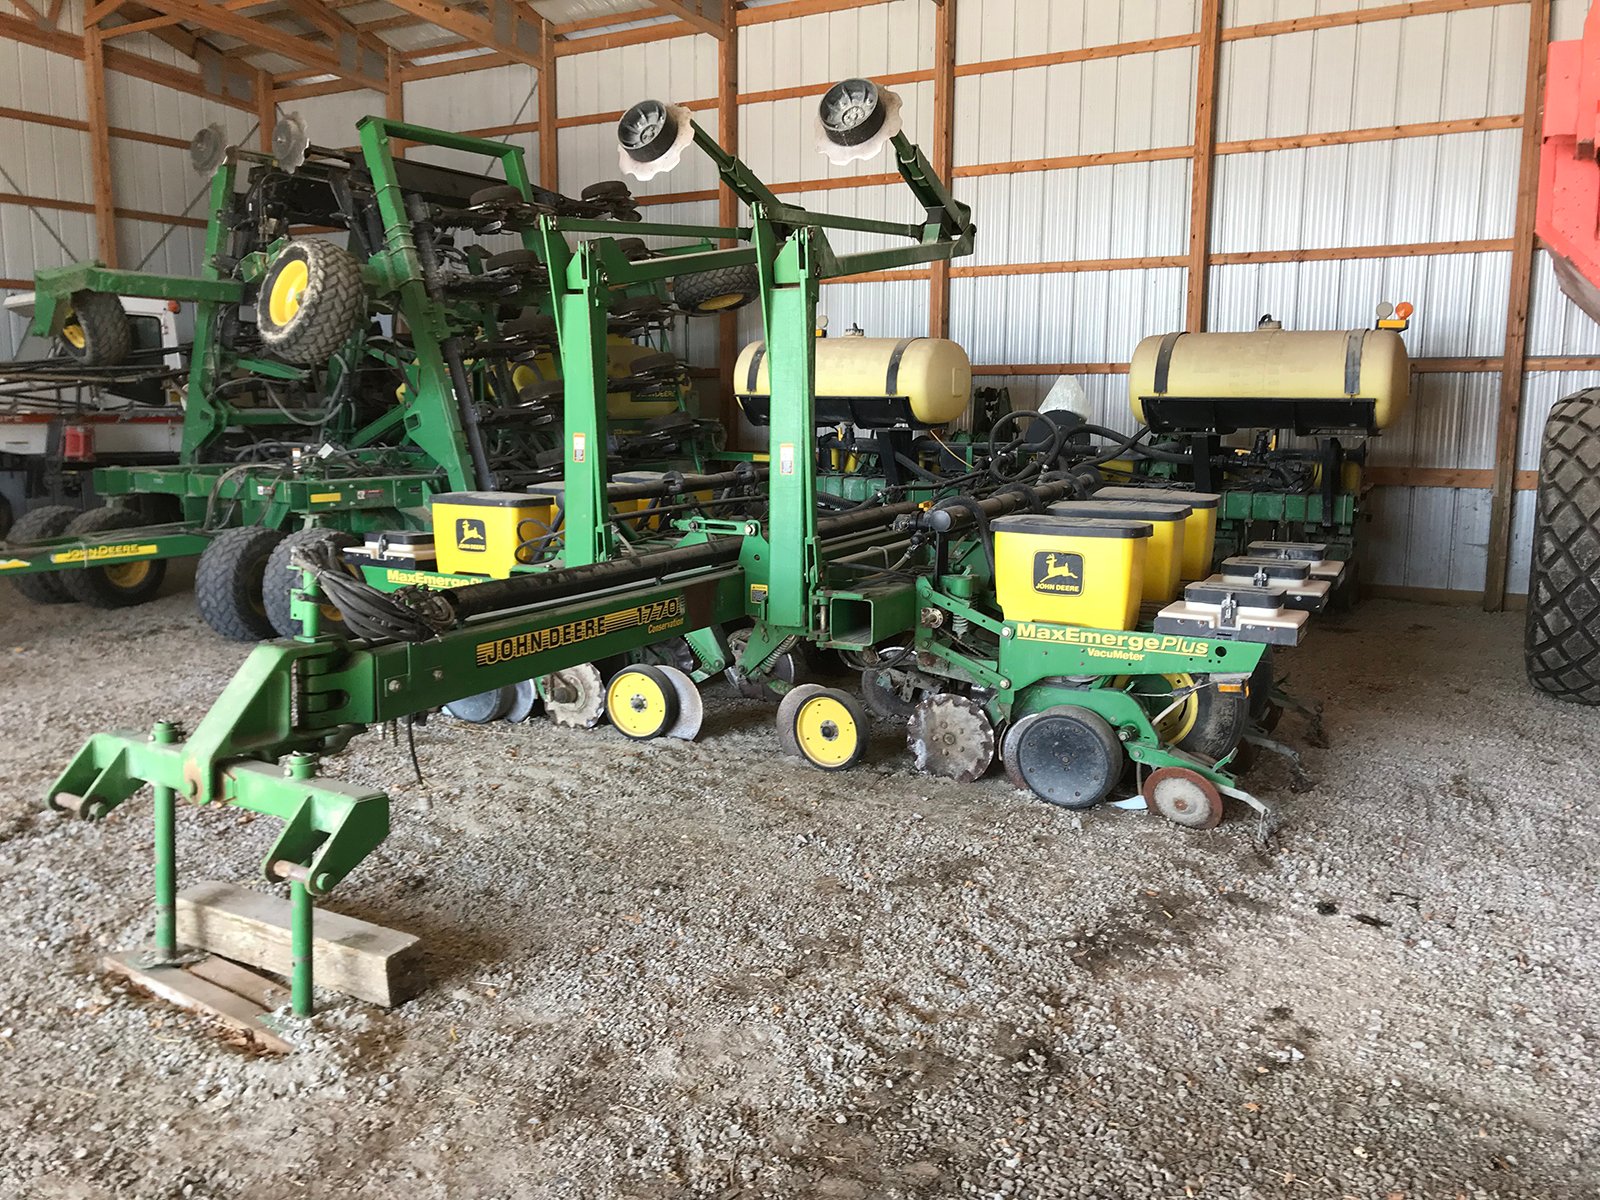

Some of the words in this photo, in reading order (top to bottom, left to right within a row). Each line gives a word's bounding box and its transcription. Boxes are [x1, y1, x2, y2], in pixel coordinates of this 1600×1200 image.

[98, 544, 139, 557] DEERE
[1055, 584, 1079, 592] DEERE
[486, 631, 542, 664] JOHN
[548, 616, 607, 647] DEERE
[637, 599, 678, 625] 1770
[647, 617, 684, 634] Conservation
[1087, 647, 1145, 662] VacuMeter
